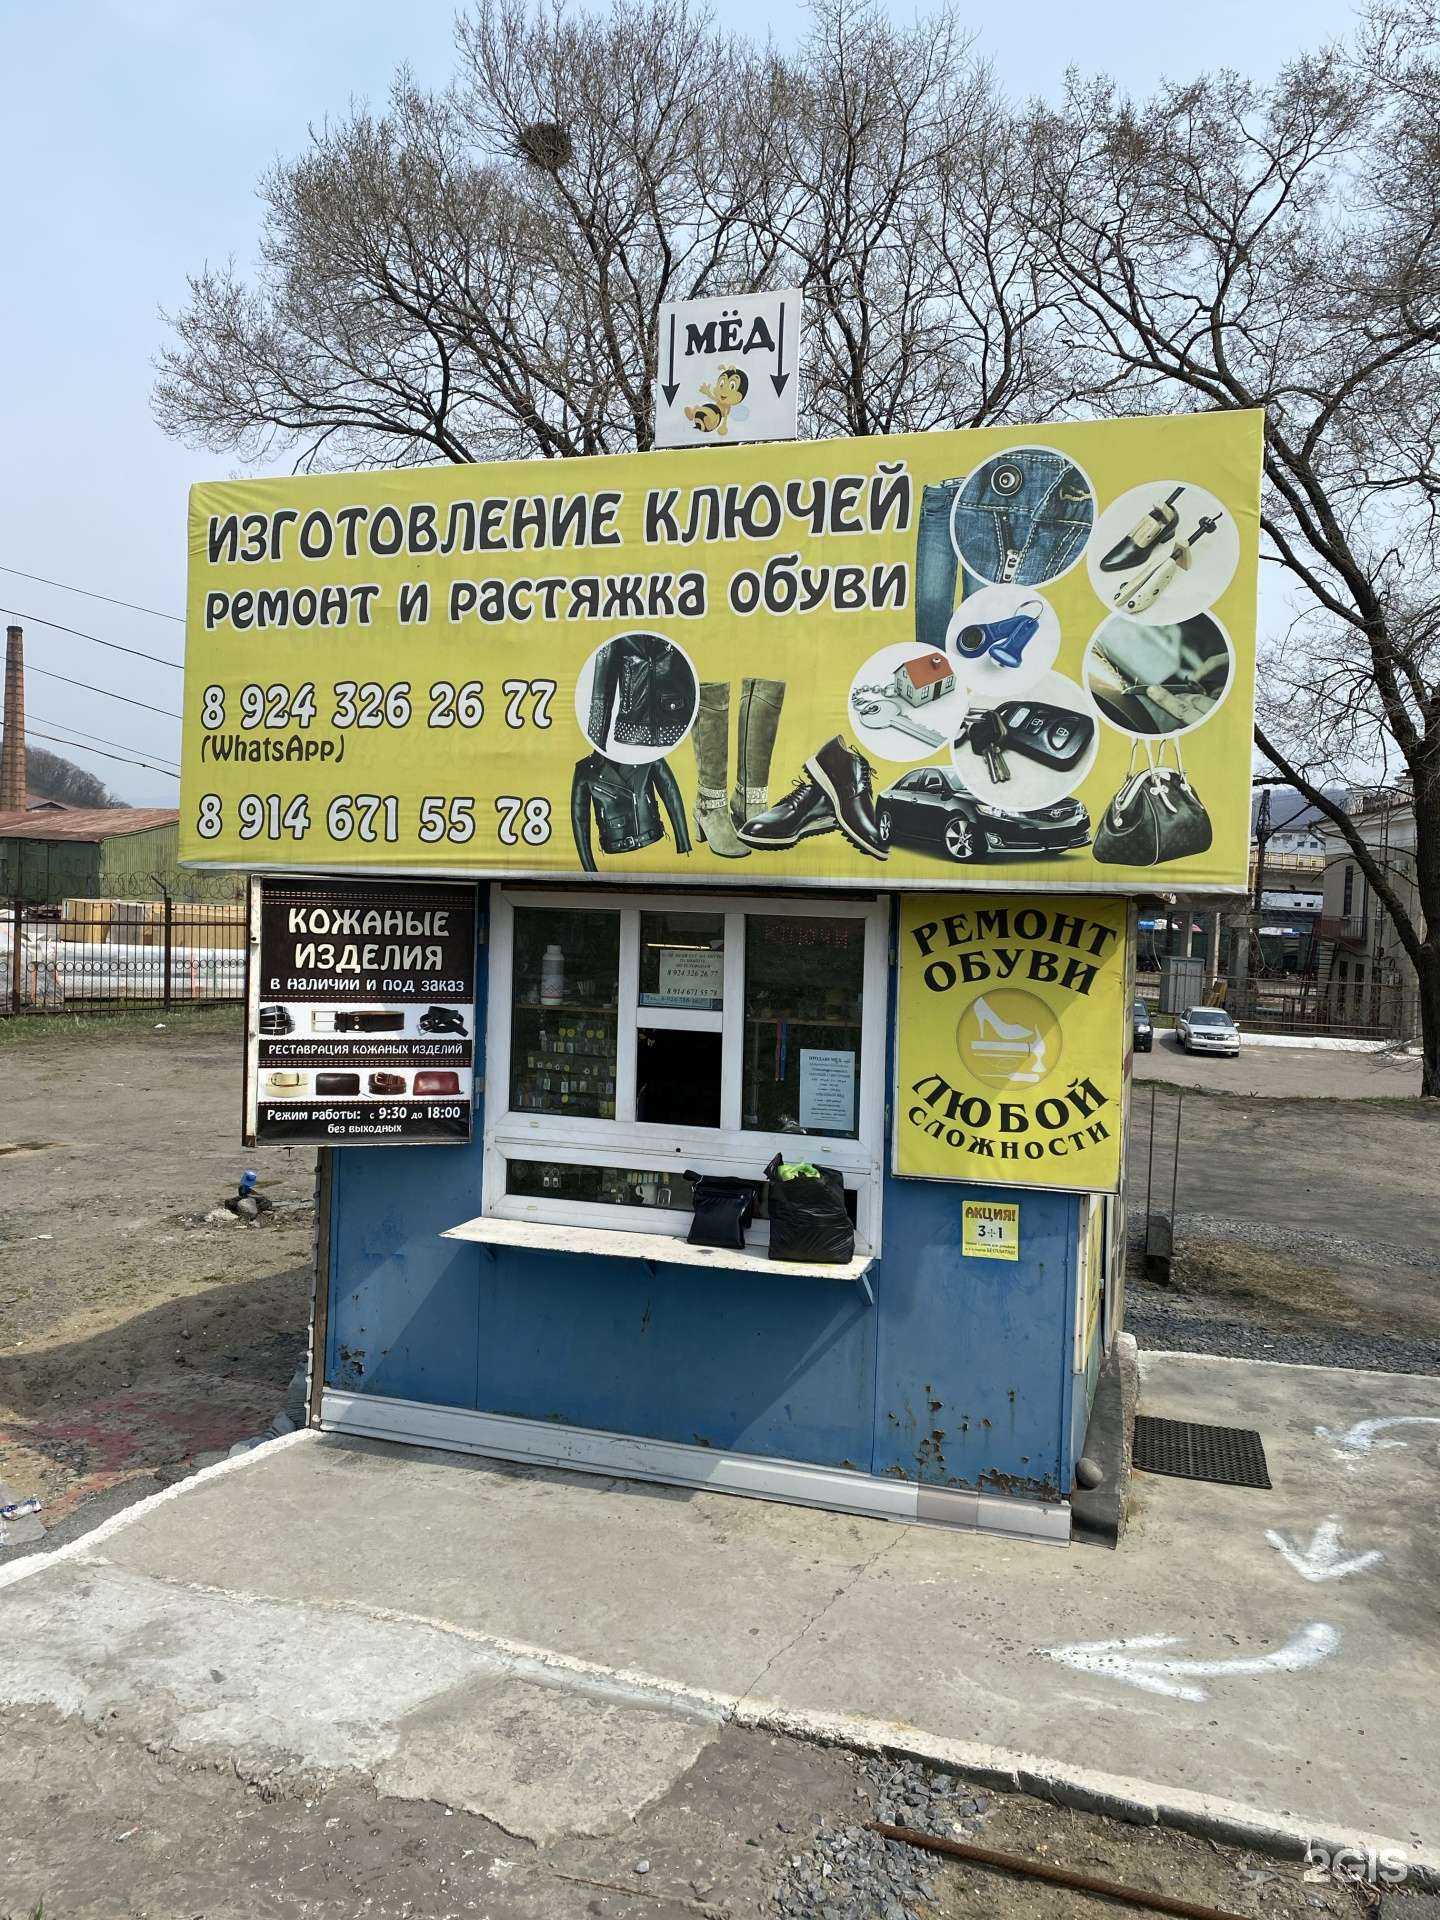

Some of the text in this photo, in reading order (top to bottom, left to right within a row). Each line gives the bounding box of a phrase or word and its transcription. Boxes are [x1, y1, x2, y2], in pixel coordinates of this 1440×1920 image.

[685, 310, 775, 355] МЁД
[207, 463, 910, 563] ИЗГОТОВЛЕНИЕ КЛЮЧЕЙ
[206, 554, 906, 629] ремонт и растяжка обуви
[201, 679, 557, 730] 8 924 326 26 77
[202, 735, 344, 762] (WhatsApp)
[197, 794, 552, 846] 8 914 671 55 78
[288, 908, 450, 937] КОЖАНЫЕ
[910, 908, 1118, 958] РЕМОНТ
[295, 943, 443, 974] ИЗДЕЛИЯ
[923, 948, 1101, 996] ОБУВИ
[271, 978, 464, 993] в наличии и под заказ
[268, 1043, 463, 1056] РЕСТАВРАЦИЯ КОЖАНЫХ ИЗДЕЛИЙ
[267, 1109, 308, 1121] Режим
[312, 1109, 361, 1121] работы:
[379, 1107, 407, 1119] 9:30
[411, 1112, 423, 1120] до
[427, 1107, 461, 1119] 18:00
[911, 1073, 1109, 1133] ЛЮБОЙ
[328, 1123, 402, 1134] без выходных
[908, 1106, 1111, 1160] СЛОЖНОСТИ
[965, 1206, 1016, 1222] АКЦИЯ!
